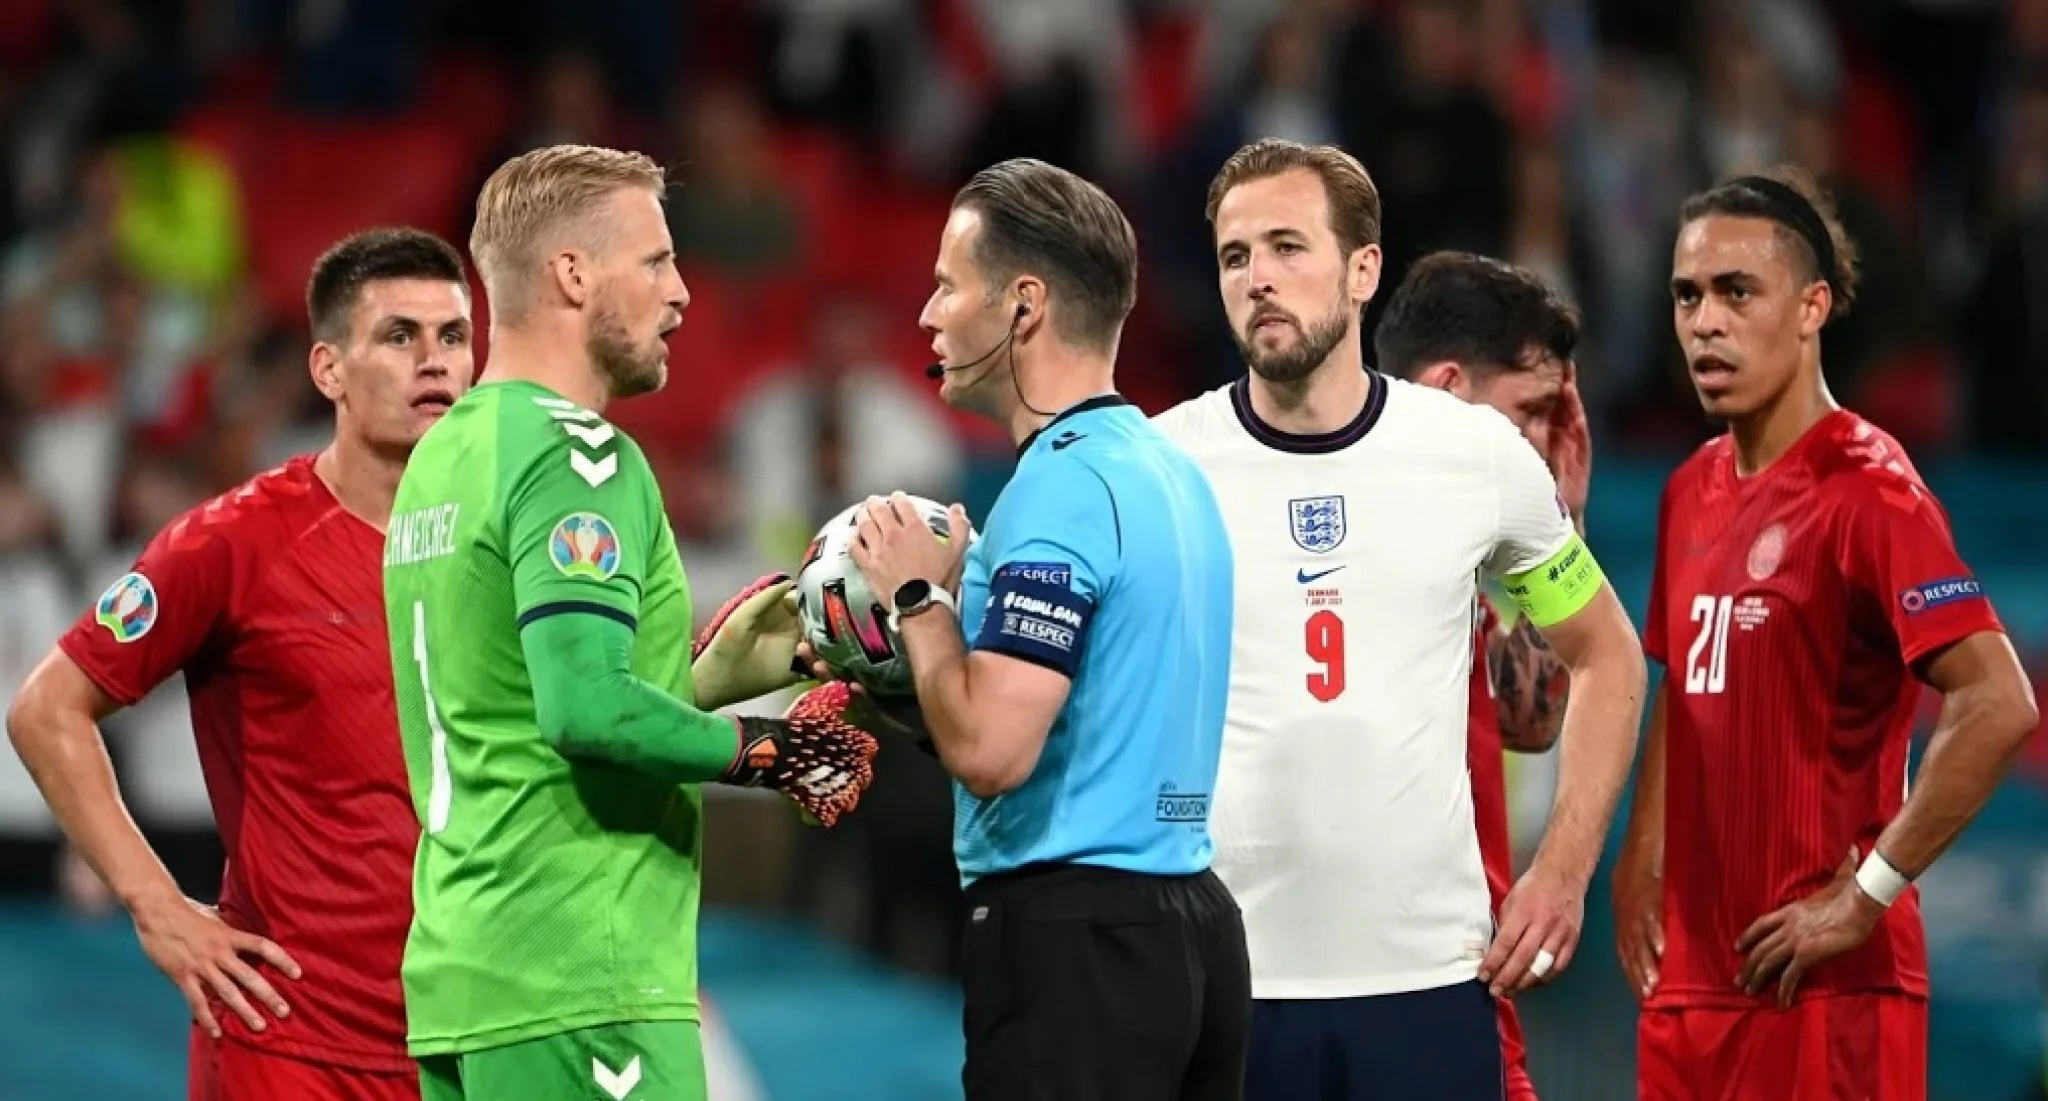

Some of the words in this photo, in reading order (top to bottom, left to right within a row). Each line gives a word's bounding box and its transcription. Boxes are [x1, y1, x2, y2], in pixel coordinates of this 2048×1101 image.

[1020, 619, 1074, 647] RESPECT
[1924, 581, 1979, 600] RESPECT
[1305, 610, 1344, 701] 9
[1685, 594, 1733, 693] 20
[413, 600, 452, 834] 1
